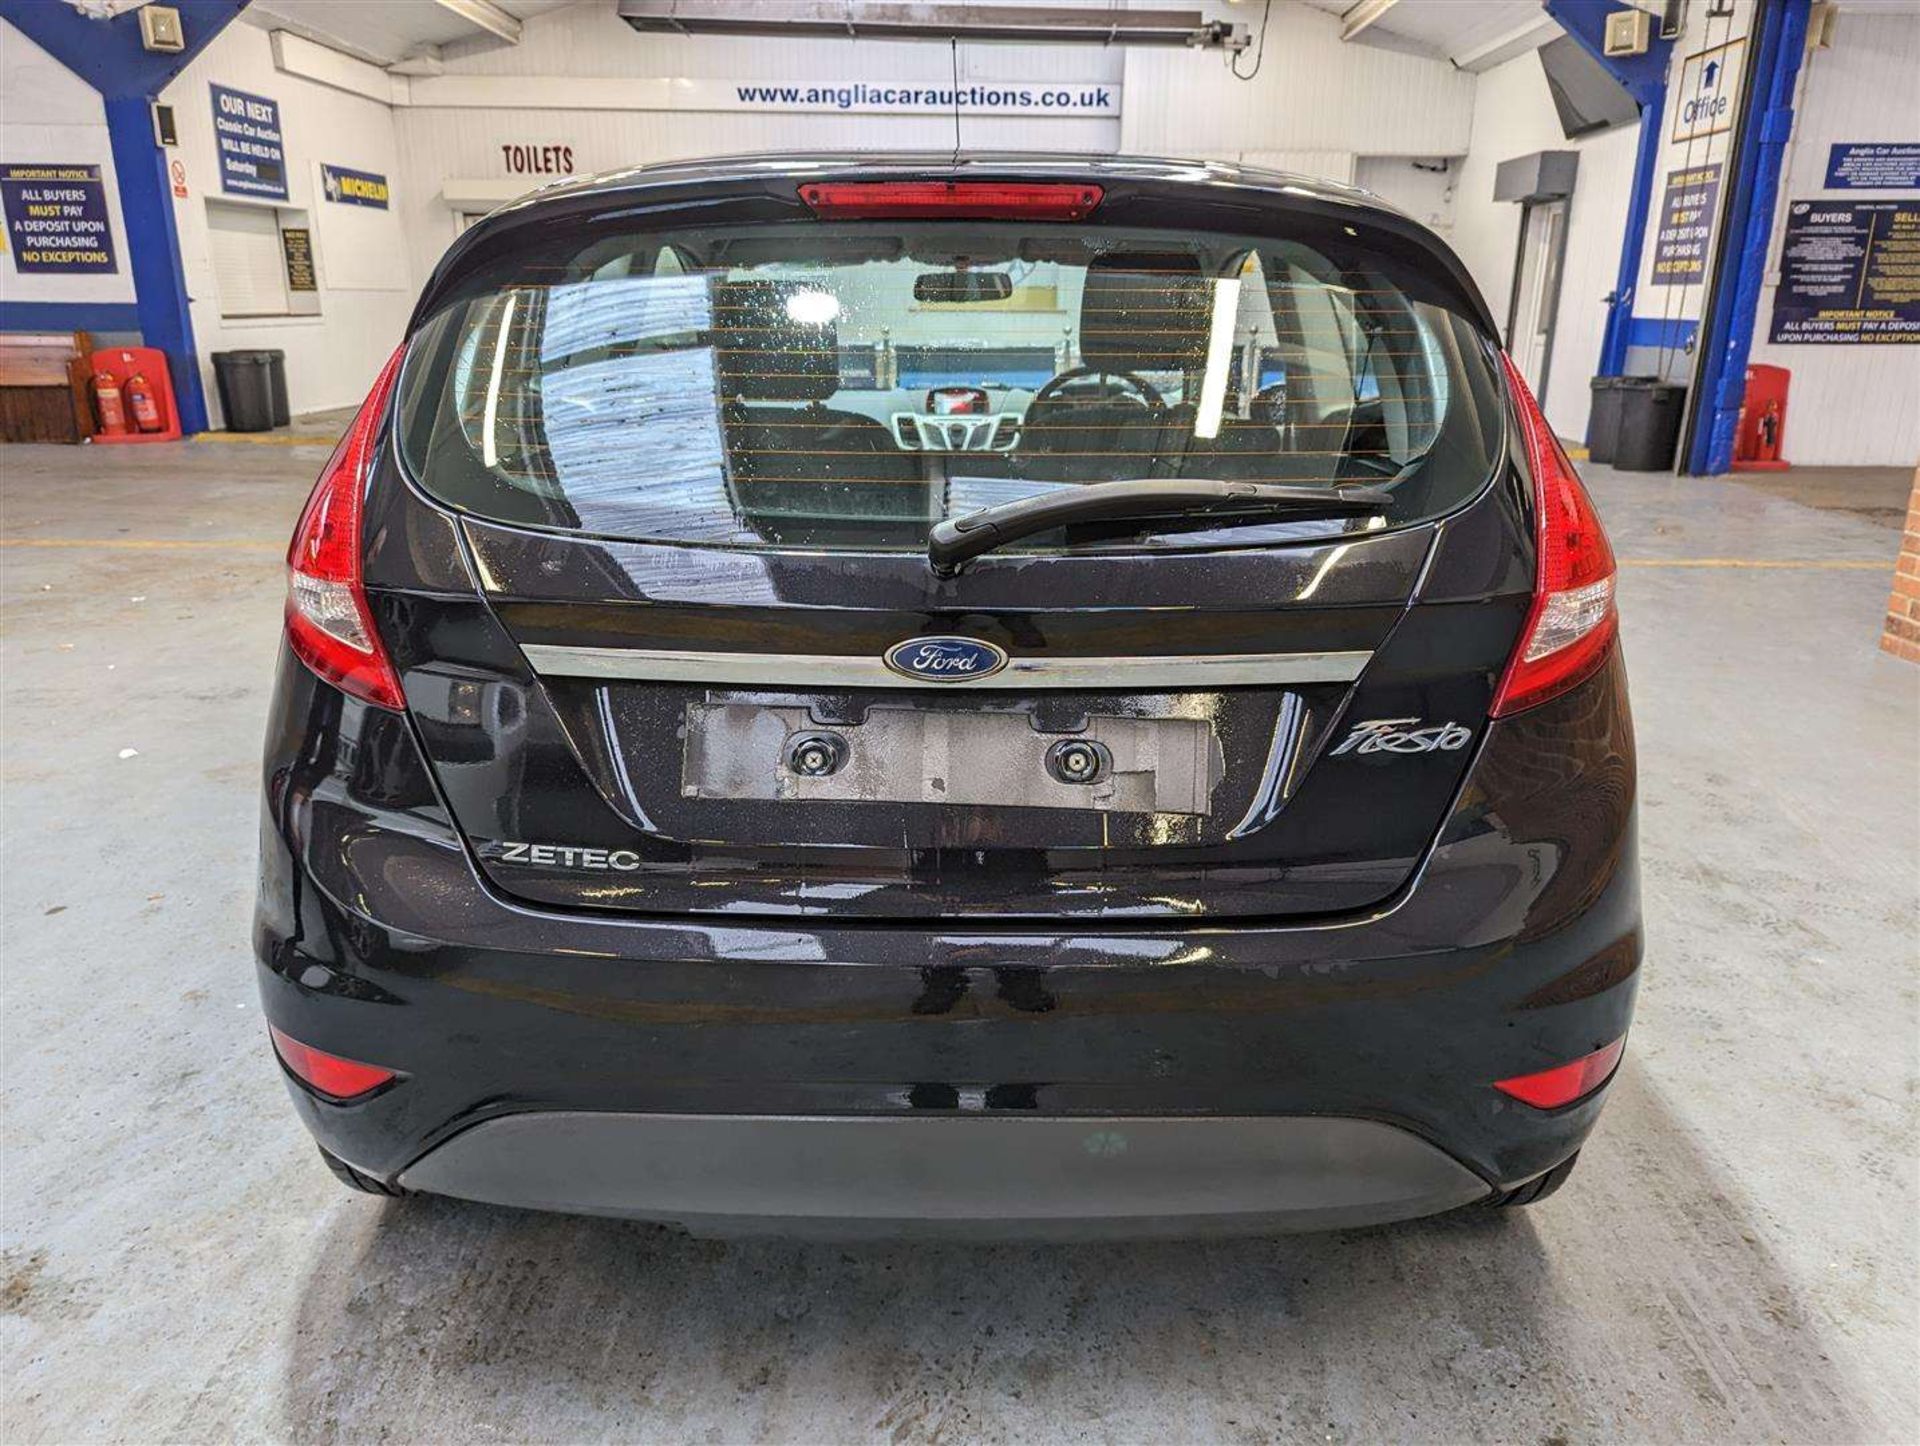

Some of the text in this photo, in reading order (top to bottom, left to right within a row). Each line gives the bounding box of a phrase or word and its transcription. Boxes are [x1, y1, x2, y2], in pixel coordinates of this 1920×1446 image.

[737, 84, 1111, 108] www.angliacarauctions.co.uk
[220, 93, 273, 123] OUR NEXT
[1684, 95, 1727, 123] Office
[502, 145, 573, 174] TOILETS
[59, 169, 88, 179] NOTICE
[22, 189, 86, 201] ALL BUYERS
[29, 205, 84, 217] MUST PAY
[1810, 213, 1852, 223] BUYERS
[15, 220, 105, 232] A DEPOSIT UPON
[27, 236, 98, 248] PURCHASING
[22, 251, 108, 263] NO EXCEPTIONS
[1784, 321, 1800, 331] ALL
[1801, 321, 1834, 331] BUYERS
[1836, 321, 1861, 331] MUST
[1862, 321, 1878, 331] PAY
[1879, 321, 1887, 331] A
[1777, 333, 1802, 342] UPON
[1804, 333, 1859, 342] PURCHASING
[1860, 333, 1874, 342] NO
[913, 644, 978, 670] Ford
[1328, 717, 1472, 756] Fiesta
[502, 841, 640, 871] ZETEC
